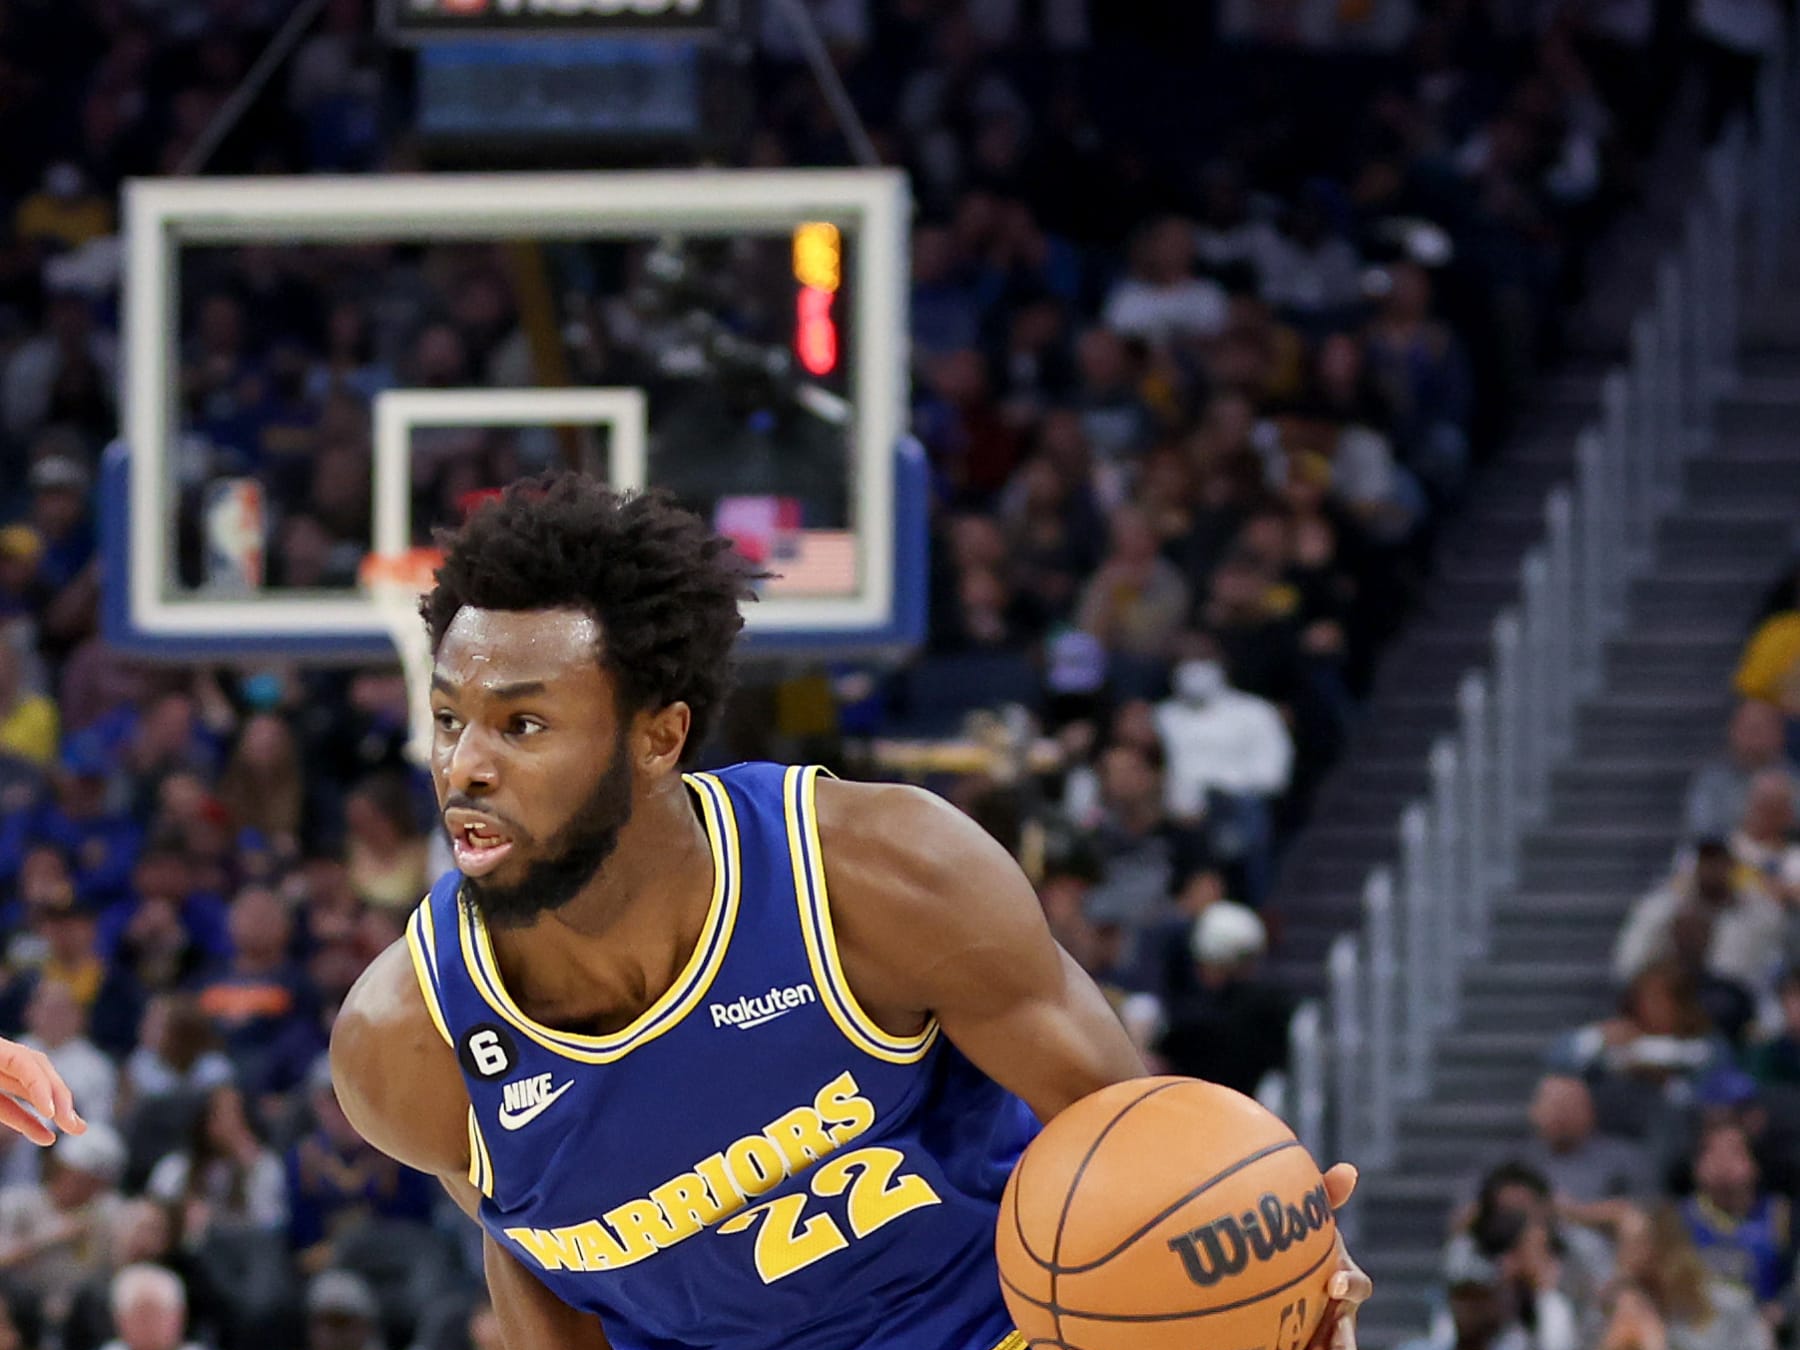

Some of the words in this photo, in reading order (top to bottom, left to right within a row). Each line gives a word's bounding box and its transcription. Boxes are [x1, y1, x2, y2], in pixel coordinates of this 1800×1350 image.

[709, 983, 816, 1028] Rakuten
[468, 1029, 509, 1077] 6
[502, 1072, 553, 1113] NIKE
[504, 1070, 876, 1273] WARRIORS
[716, 1146, 942, 1285] 22
